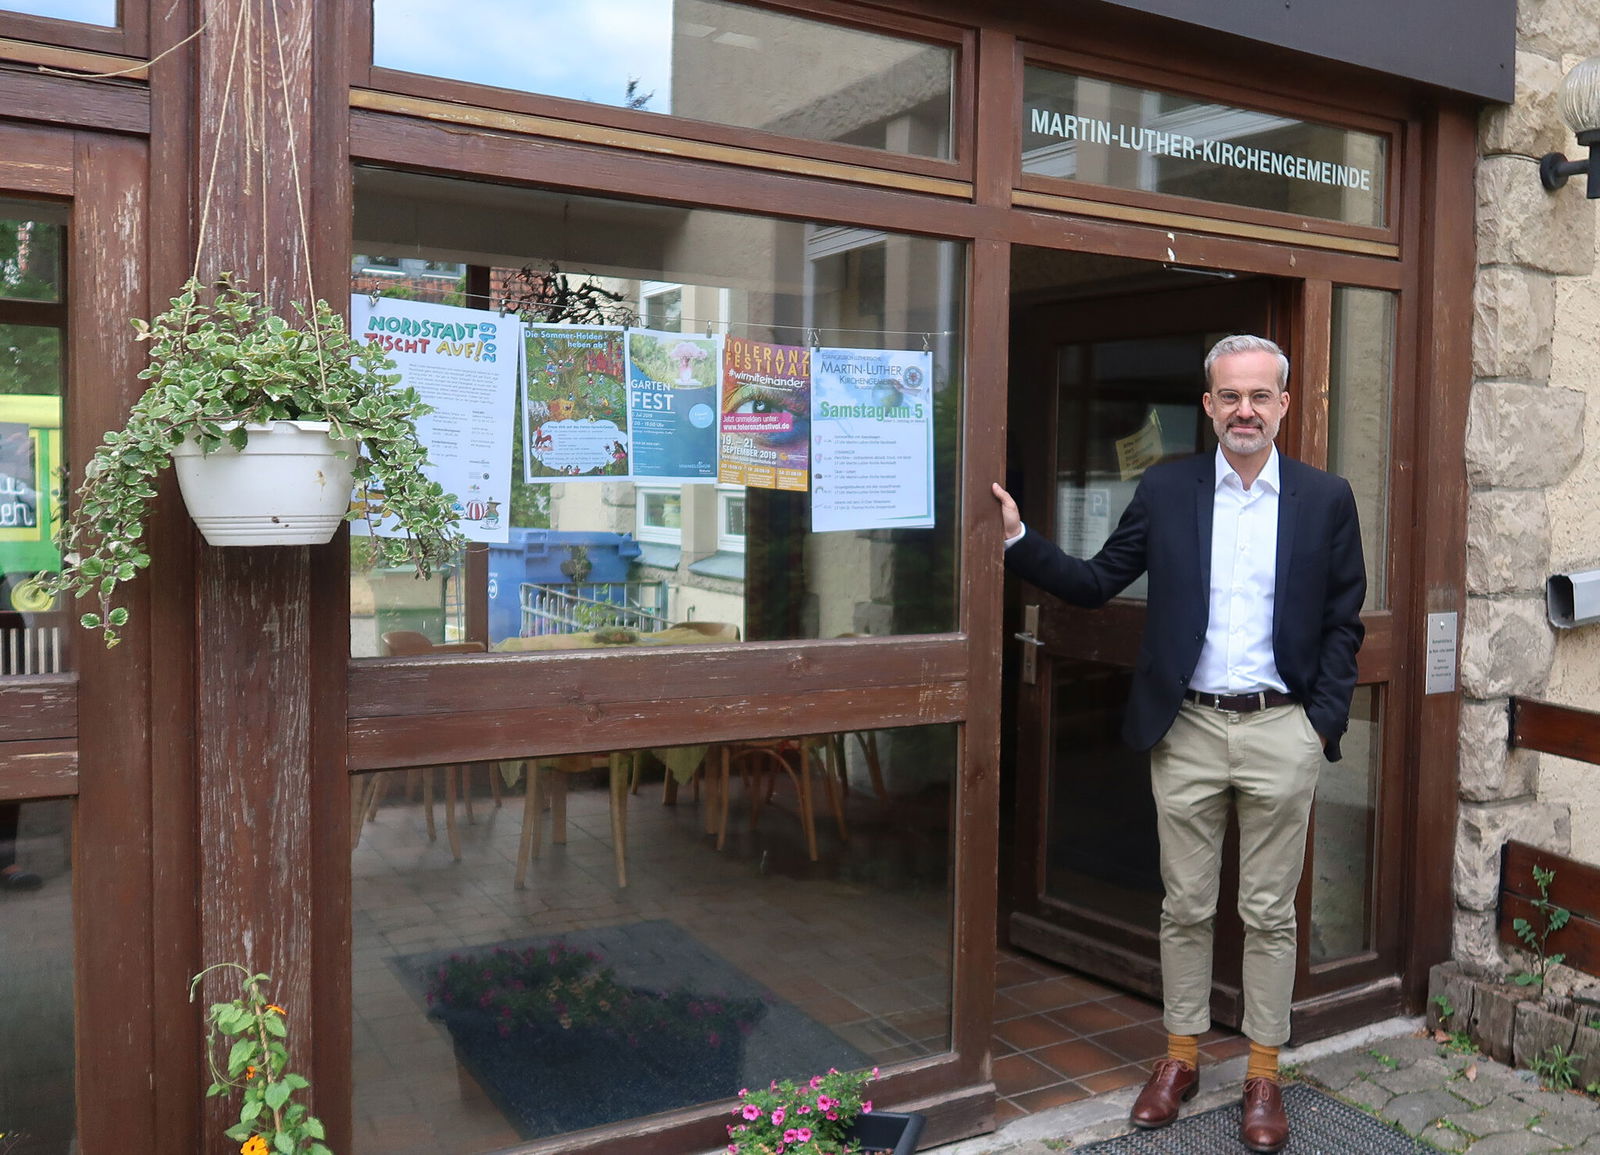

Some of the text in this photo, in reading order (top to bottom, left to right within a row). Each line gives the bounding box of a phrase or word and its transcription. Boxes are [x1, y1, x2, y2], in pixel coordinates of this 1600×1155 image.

[1031, 108, 1371, 192] MARTIN-LUTHER-KIRCHENGEMEINDE
[368, 315, 477, 341] NORDSTADT
[525, 330, 603, 340] Die Sommer-Helden
[364, 333, 430, 353] TISCHT
[435, 341, 484, 362] AUF!
[479, 321, 497, 363] 2019
[726, 339, 810, 364] TOLERANZ
[725, 352, 809, 377] FESTIVAL
[820, 361, 902, 376] MARTIN-LUTHER
[630, 379, 671, 391] GARTEN
[728, 368, 805, 388] #wirmiteinander
[631, 391, 674, 411] FEST
[820, 401, 923, 421] Samstag um 5
[722, 445, 758, 457] SEPTEMBER
[760, 451, 777, 460] 2019
[744, 438, 756, 448] 21.
